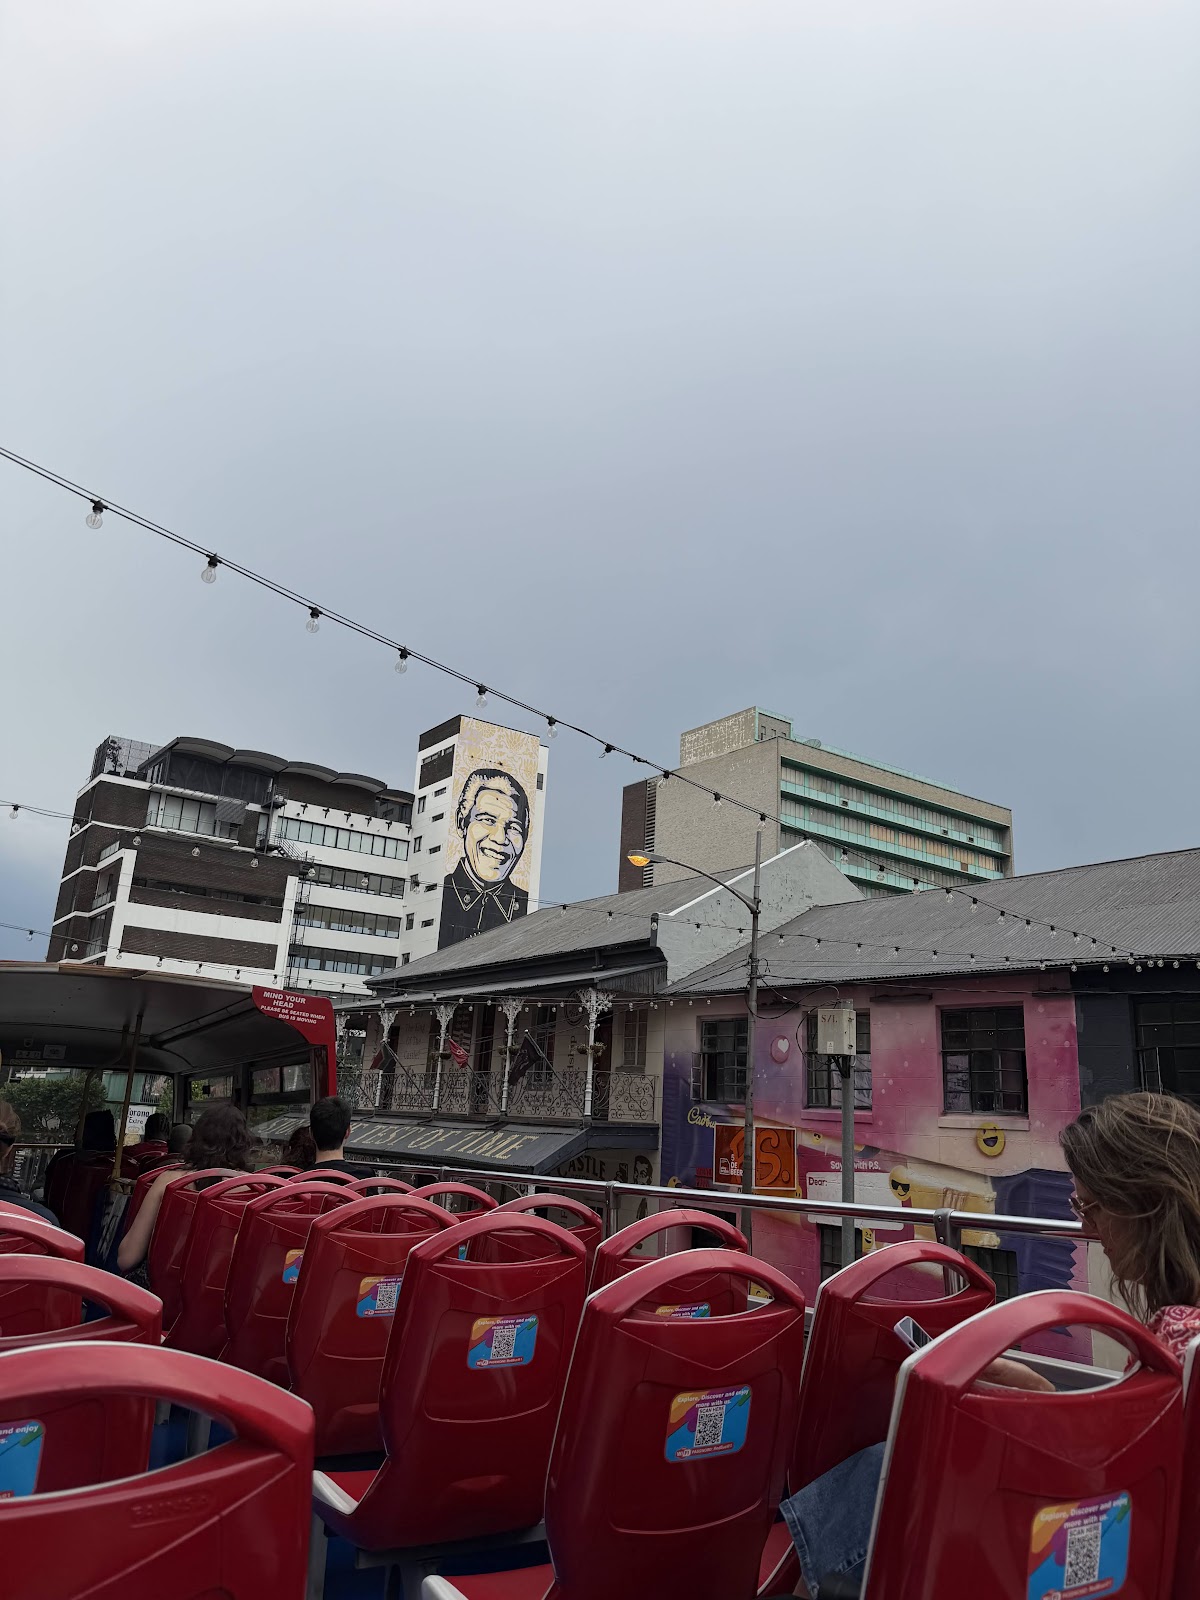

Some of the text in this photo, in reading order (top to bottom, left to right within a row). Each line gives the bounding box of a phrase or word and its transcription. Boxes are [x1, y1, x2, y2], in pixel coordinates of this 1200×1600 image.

[263, 991, 306, 1004] MIND YOUR
[273, 1000, 294, 1008] HEAD
[260, 1005, 281, 1013] PLEASE
[289, 1009, 310, 1018] SEATED
[296, 1016, 317, 1024] MOVING
[351, 1124, 426, 1146] TEST
[408, 1129, 463, 1150] OF
[443, 1130, 539, 1160] TIME
[731, 1161, 738, 1169] DE
[830, 1160, 843, 1171] Say
[808, 1177, 828, 1187] Dear:
[711, 1399, 724, 1407] with
[15, 1425, 39, 1434] enjoy
[1039, 1497, 1128, 1522] Explore, Discover and enjoy
[1063, 1519, 1082, 1529] more
[1083, 1514, 1098, 1523] with
